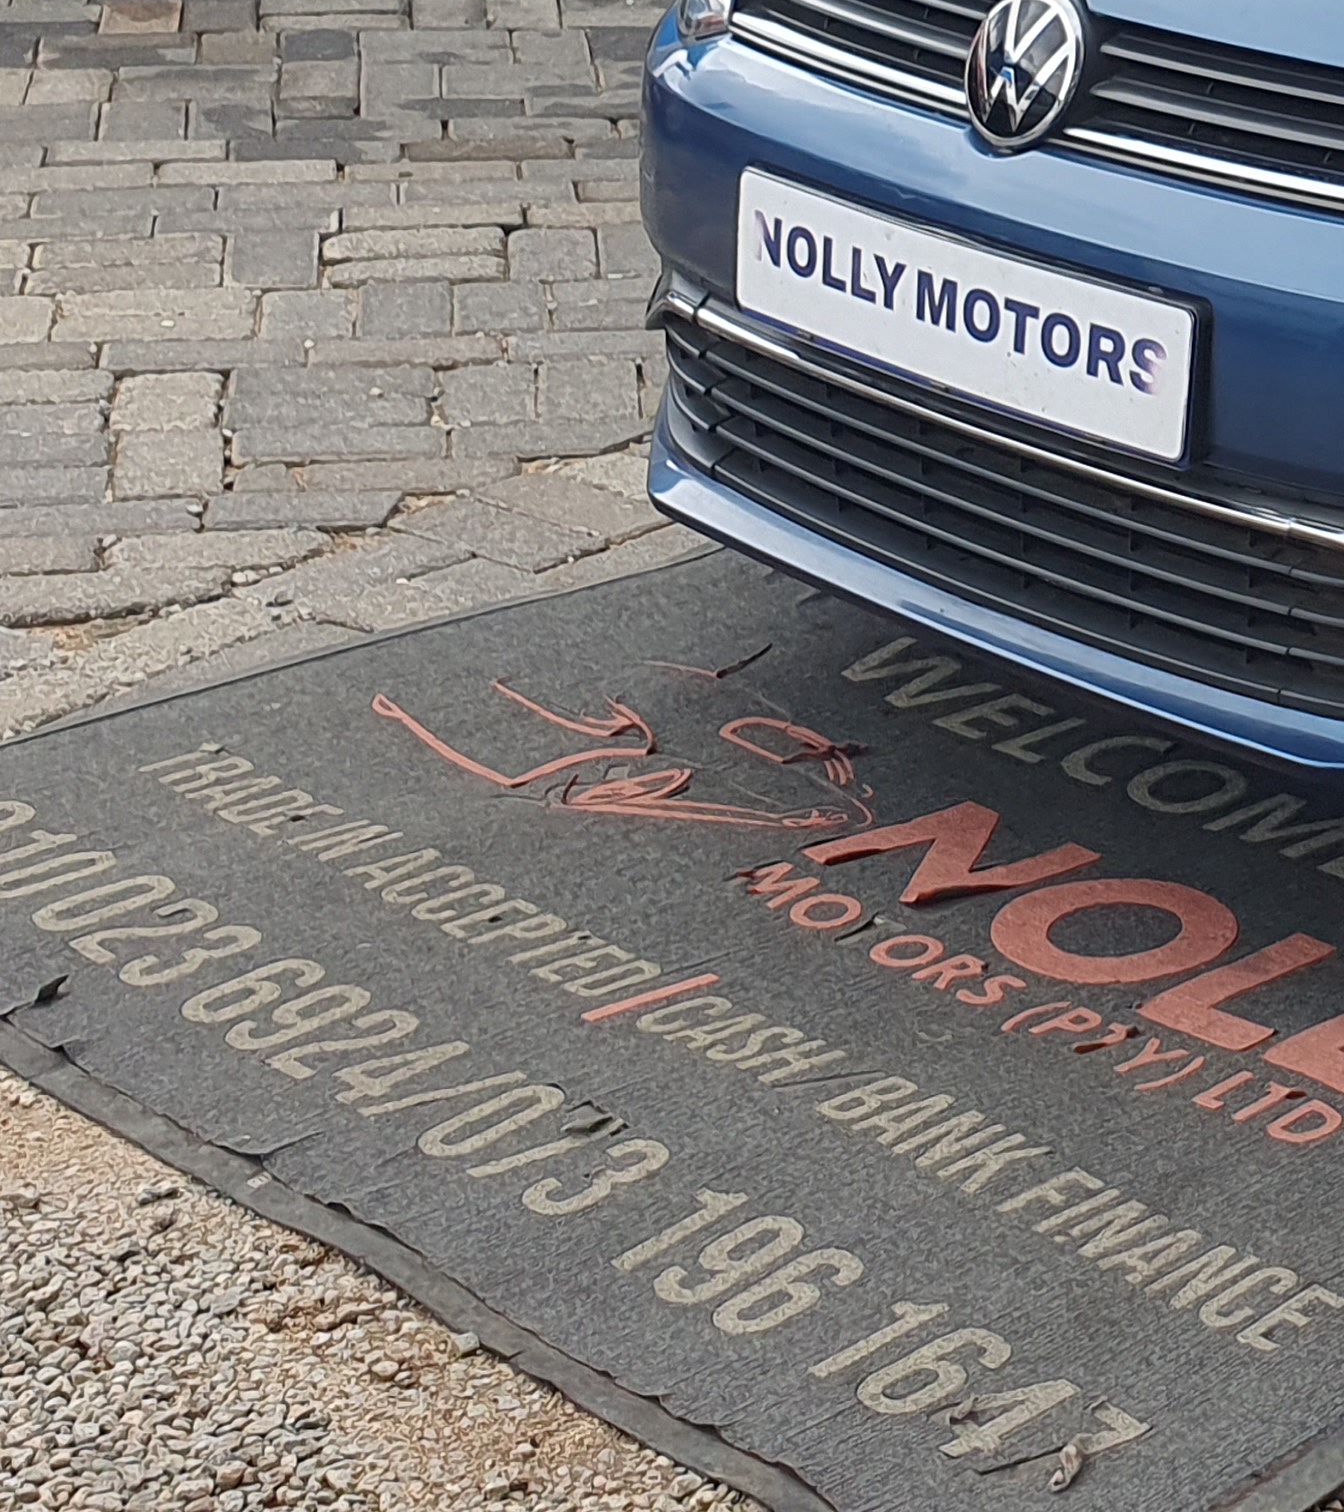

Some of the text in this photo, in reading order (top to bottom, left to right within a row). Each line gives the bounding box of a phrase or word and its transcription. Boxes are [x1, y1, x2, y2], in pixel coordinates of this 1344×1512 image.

[753, 209, 1168, 395] NOLLY MOTORS
[138, 742, 345, 837] TRADE
[283, 819, 404, 862] IN
[1192, 1071, 1343, 1144] LTD
[611, 1188, 865, 1336] 196
